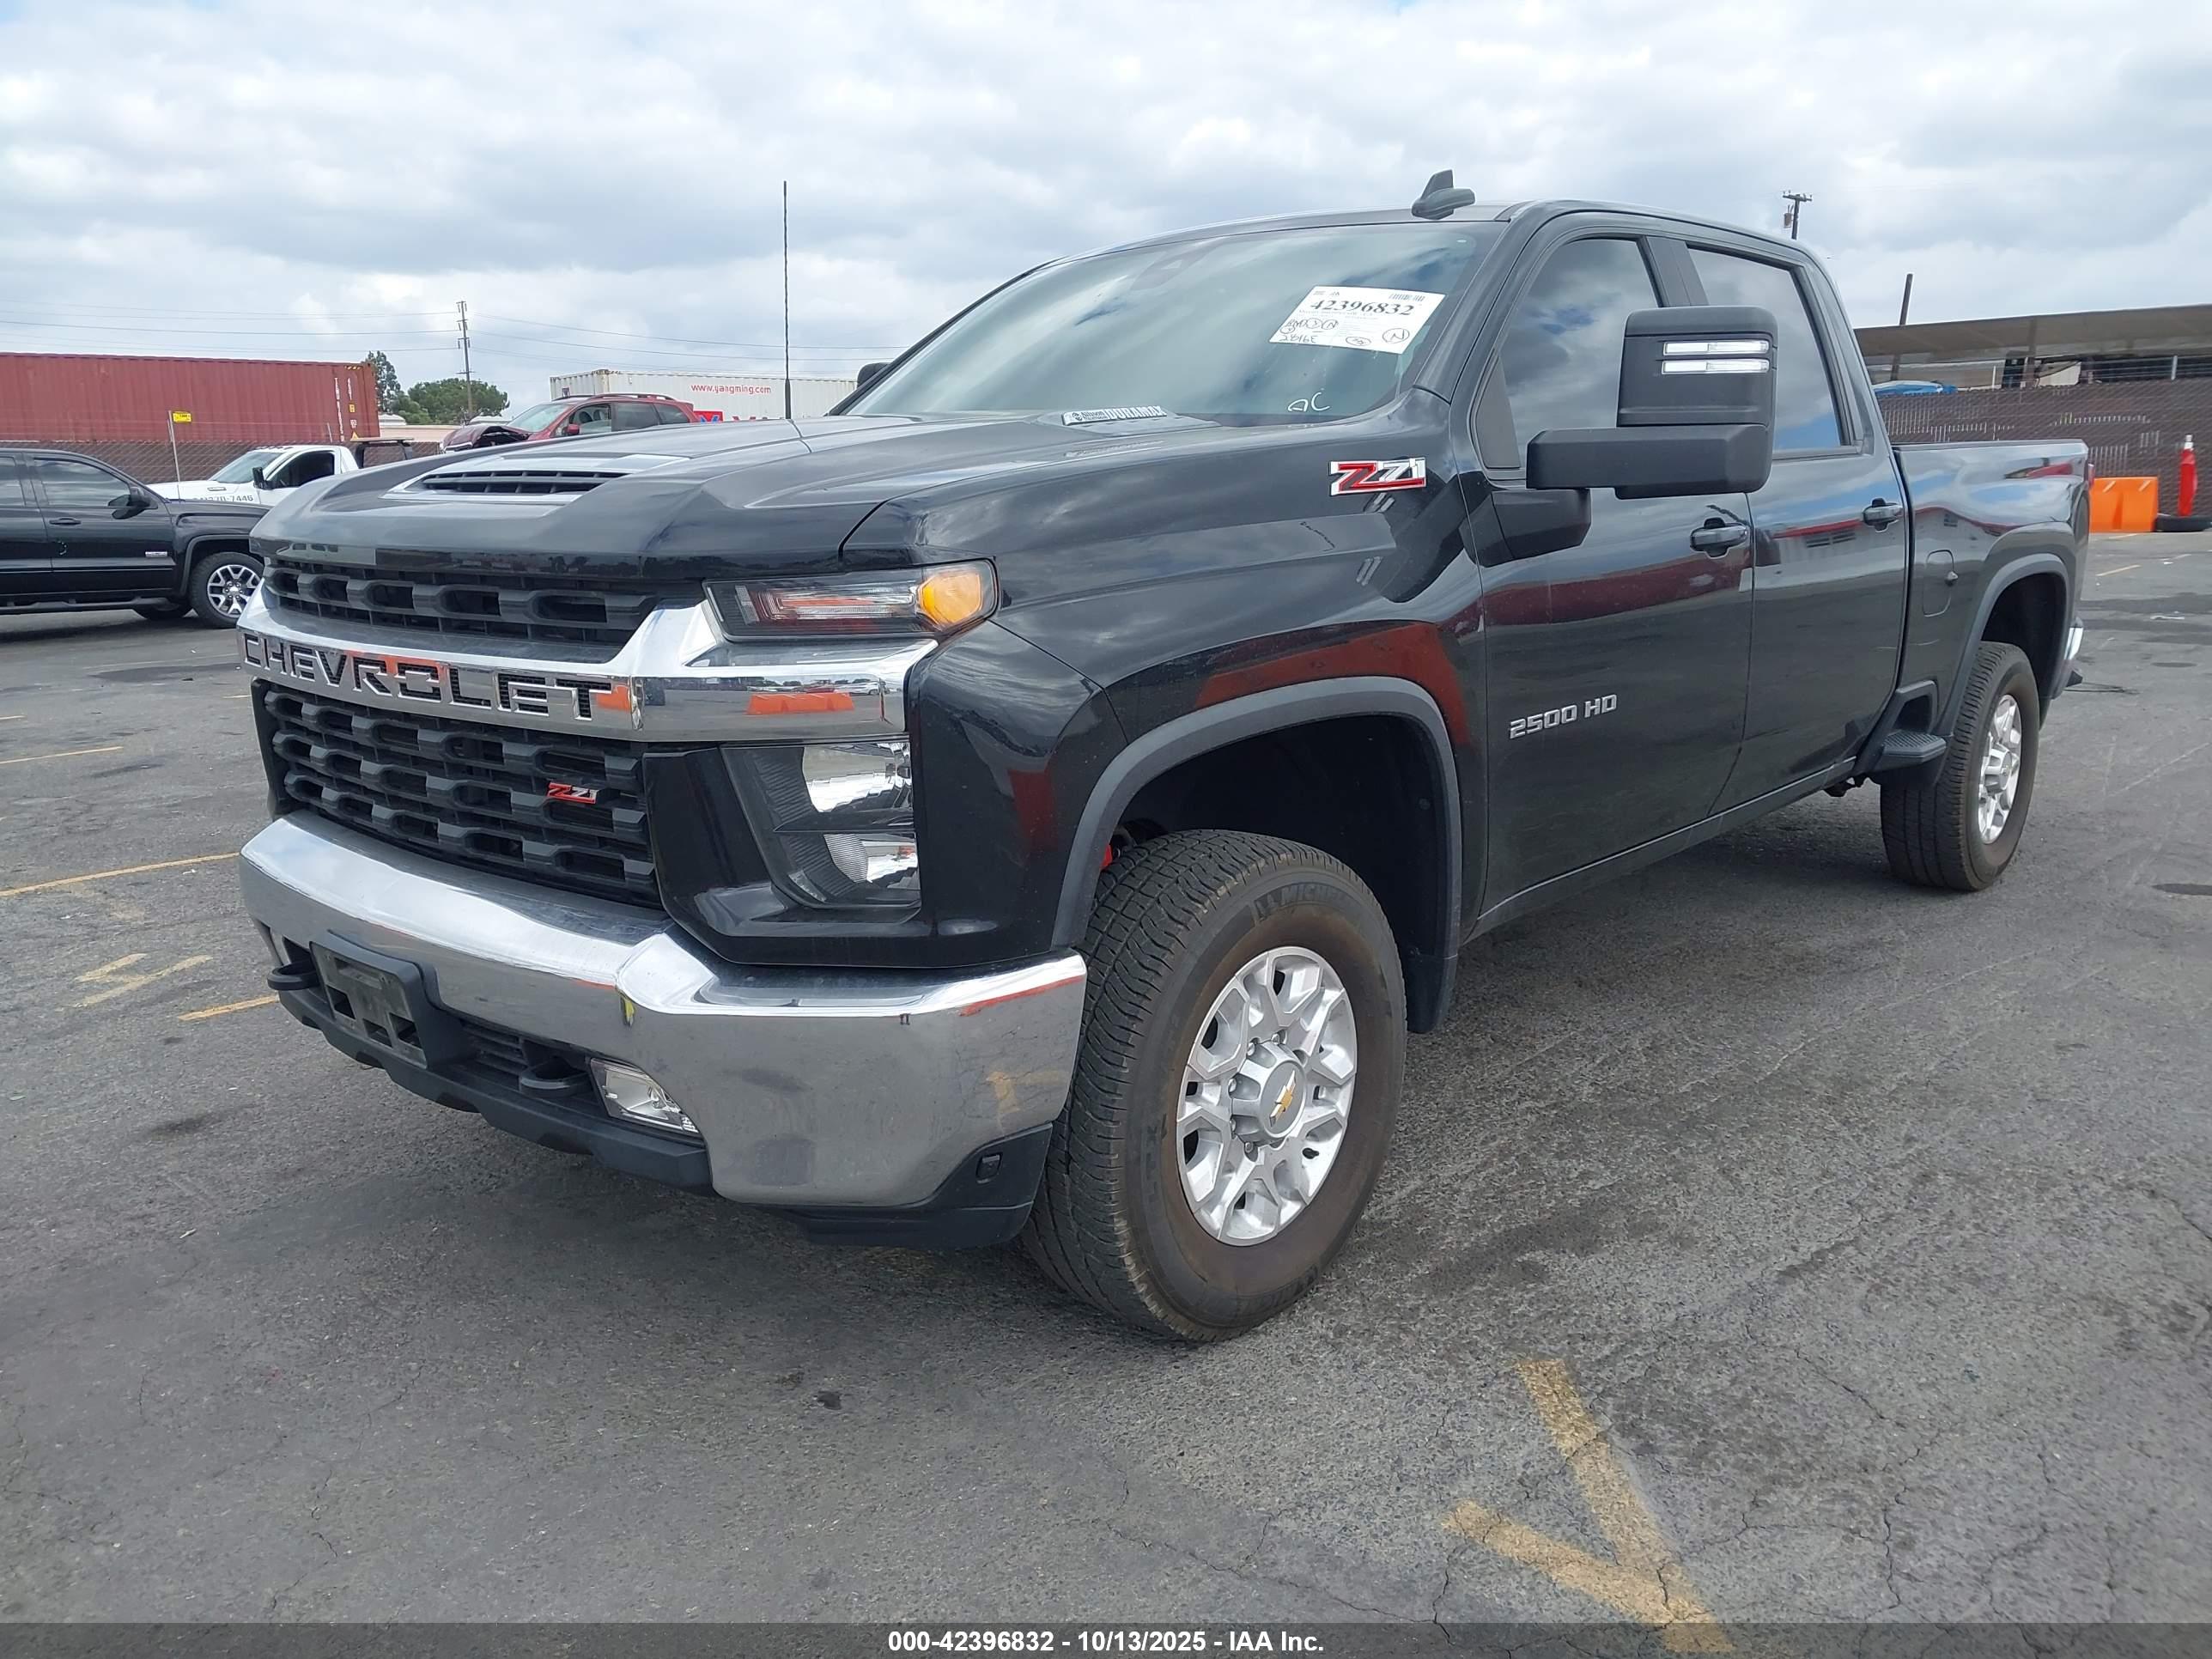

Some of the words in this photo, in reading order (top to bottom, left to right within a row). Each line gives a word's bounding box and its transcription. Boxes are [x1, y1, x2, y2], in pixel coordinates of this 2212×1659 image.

[1310, 300, 1414, 316] 42396832
[690, 384, 771, 394] www.yangming.com
[1103, 405, 1167, 420] DURAMAX
[1329, 458, 1426, 495] Z71
[243, 633, 612, 720] CHEVROLET
[1510, 704, 1578, 739] 2500
[1583, 694, 1618, 719] HD
[547, 782, 599, 805] Z71
